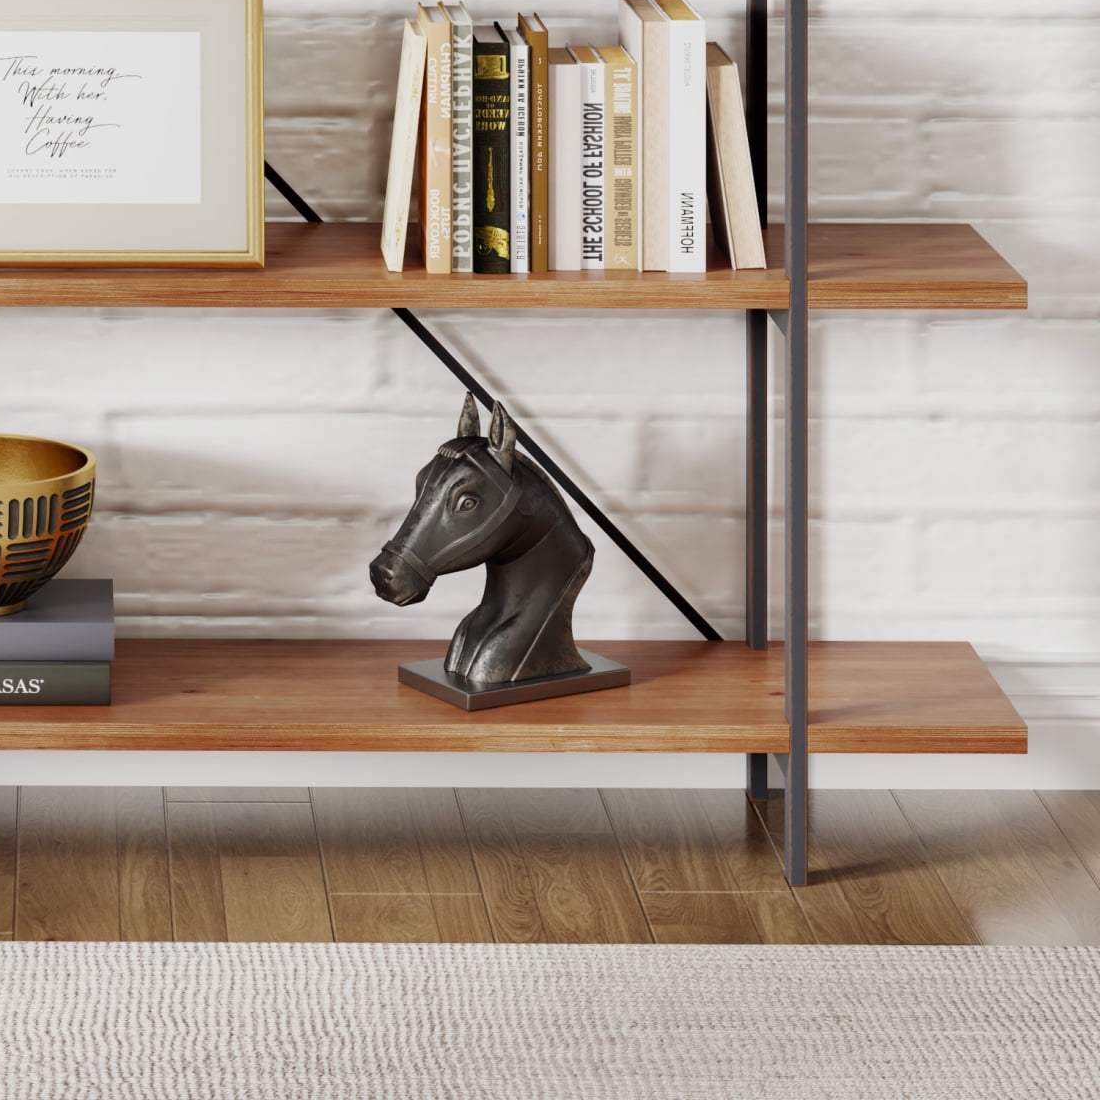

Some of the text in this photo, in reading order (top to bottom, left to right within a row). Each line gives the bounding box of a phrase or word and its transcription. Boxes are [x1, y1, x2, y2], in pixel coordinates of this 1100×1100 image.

[0, 56, 44, 81] This
[17, 76, 71, 107] With
[25, 104, 121, 136] Having
